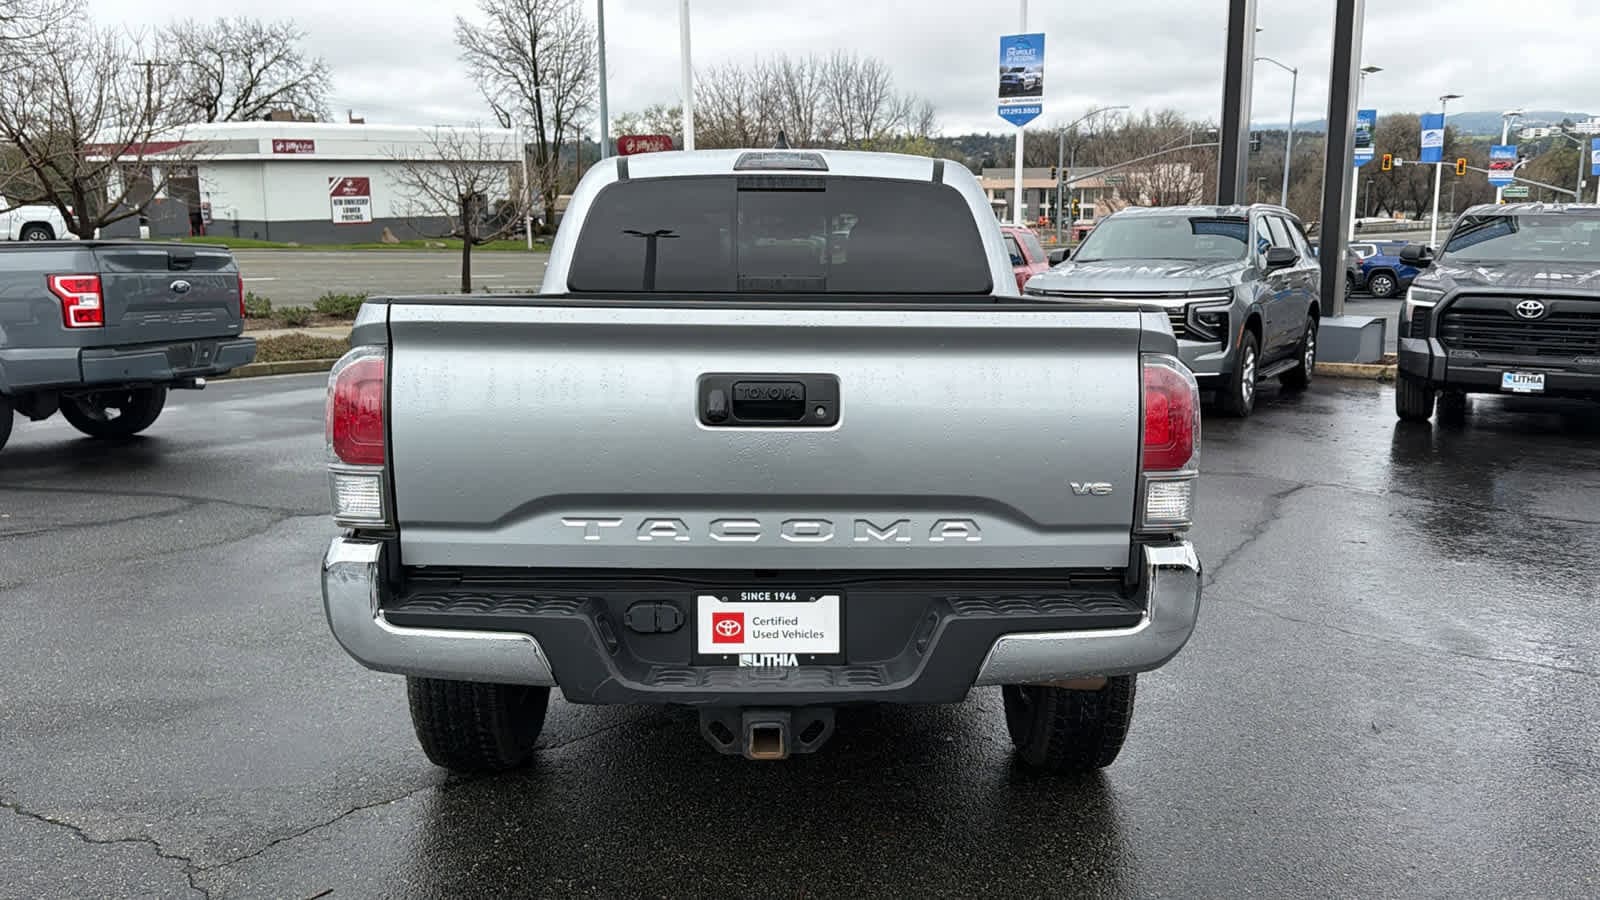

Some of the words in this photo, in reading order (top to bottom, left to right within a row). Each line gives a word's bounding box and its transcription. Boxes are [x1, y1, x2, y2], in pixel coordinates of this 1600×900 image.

[1513, 375, 1542, 384] LITHIA
[739, 388, 801, 400] TOYOTA
[1070, 482, 1113, 496] V6
[561, 516, 982, 542] TACOMA
[740, 592, 771, 600] SINCE
[774, 592, 797, 600] 1946
[752, 616, 798, 626] Certified
[752, 630, 779, 639] Used
[782, 629, 825, 639] Vehicles
[752, 653, 799, 667] LITHIA
